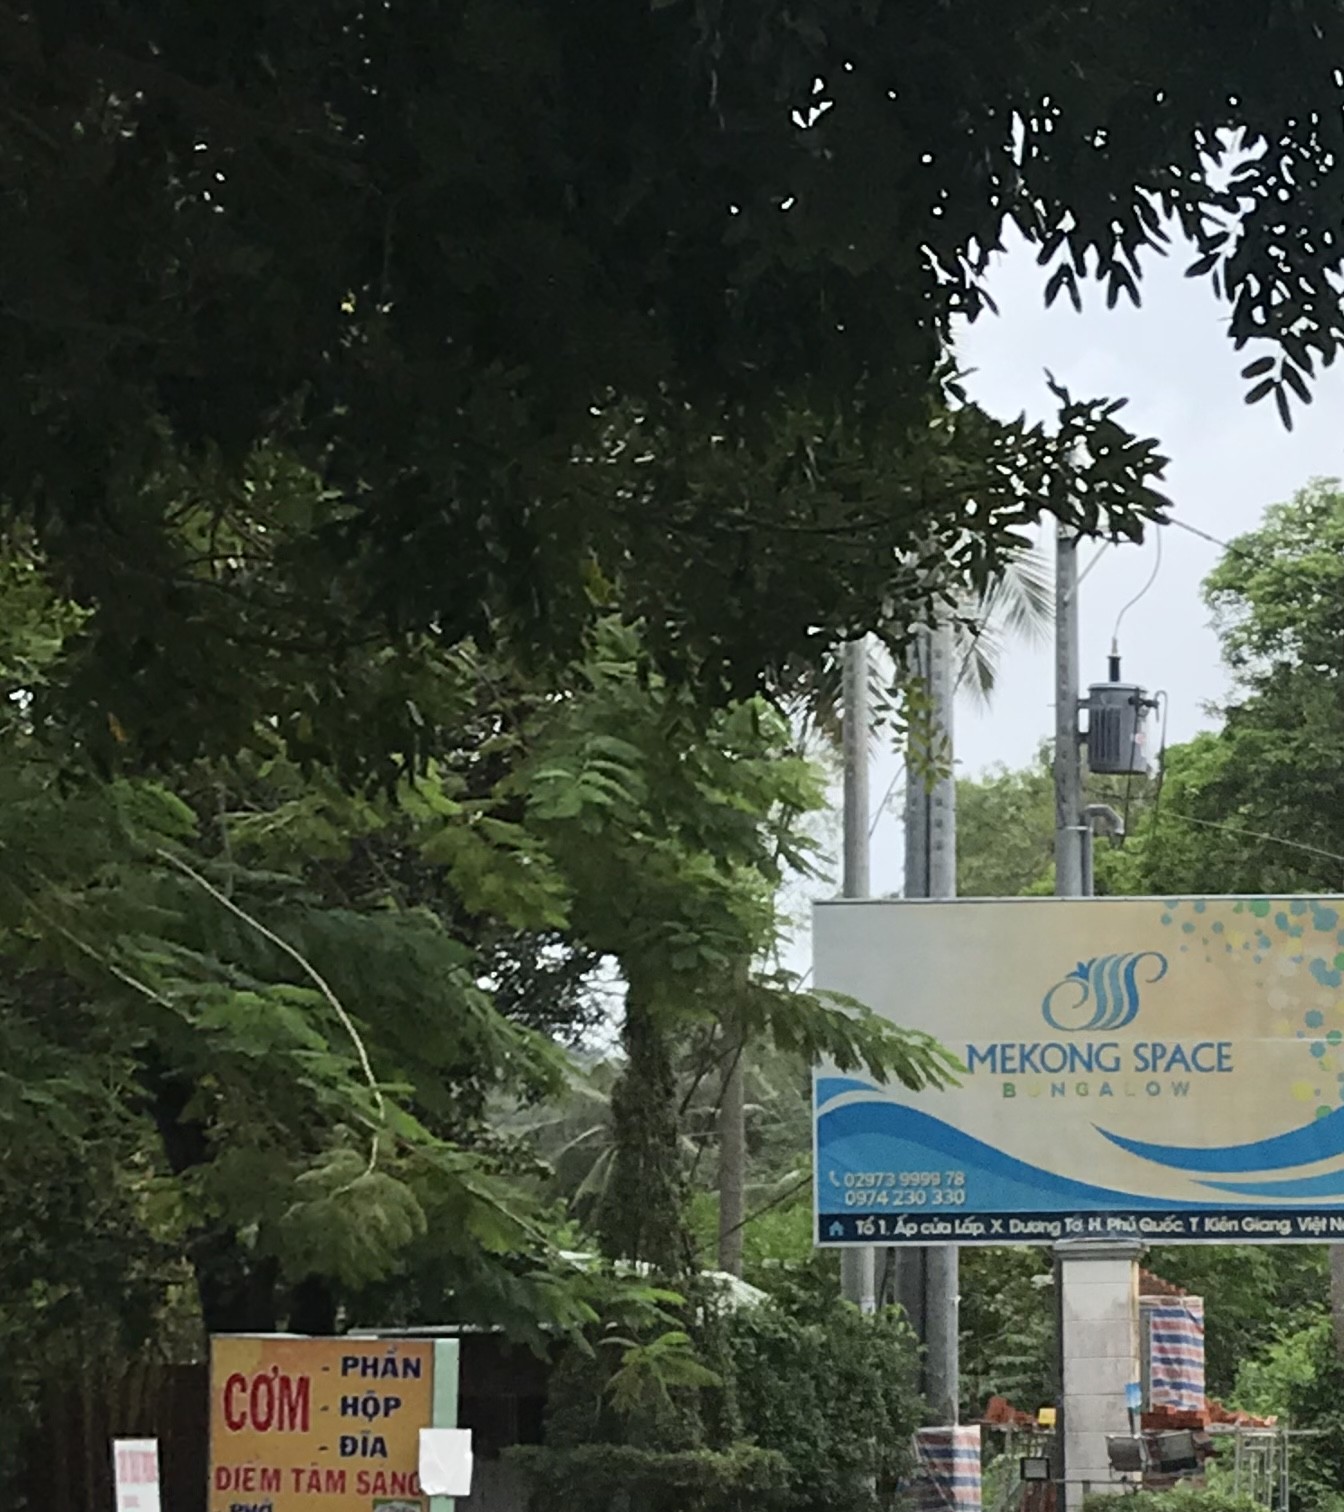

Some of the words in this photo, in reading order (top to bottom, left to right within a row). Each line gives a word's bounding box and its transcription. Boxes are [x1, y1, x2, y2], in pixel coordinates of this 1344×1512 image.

[966, 1043, 1121, 1074] MEKONG
[1133, 1042, 1234, 1073] SPACE
[1002, 1081, 1190, 1099] BUNGALOW
[945, 1171, 965, 1186] 78
[892, 1189, 926, 1206] 230
[223, 1365, 310, 1433] CƠM
[340, 1390, 402, 1423] HỘP
[339, 1430, 388, 1458] ĐĨA
